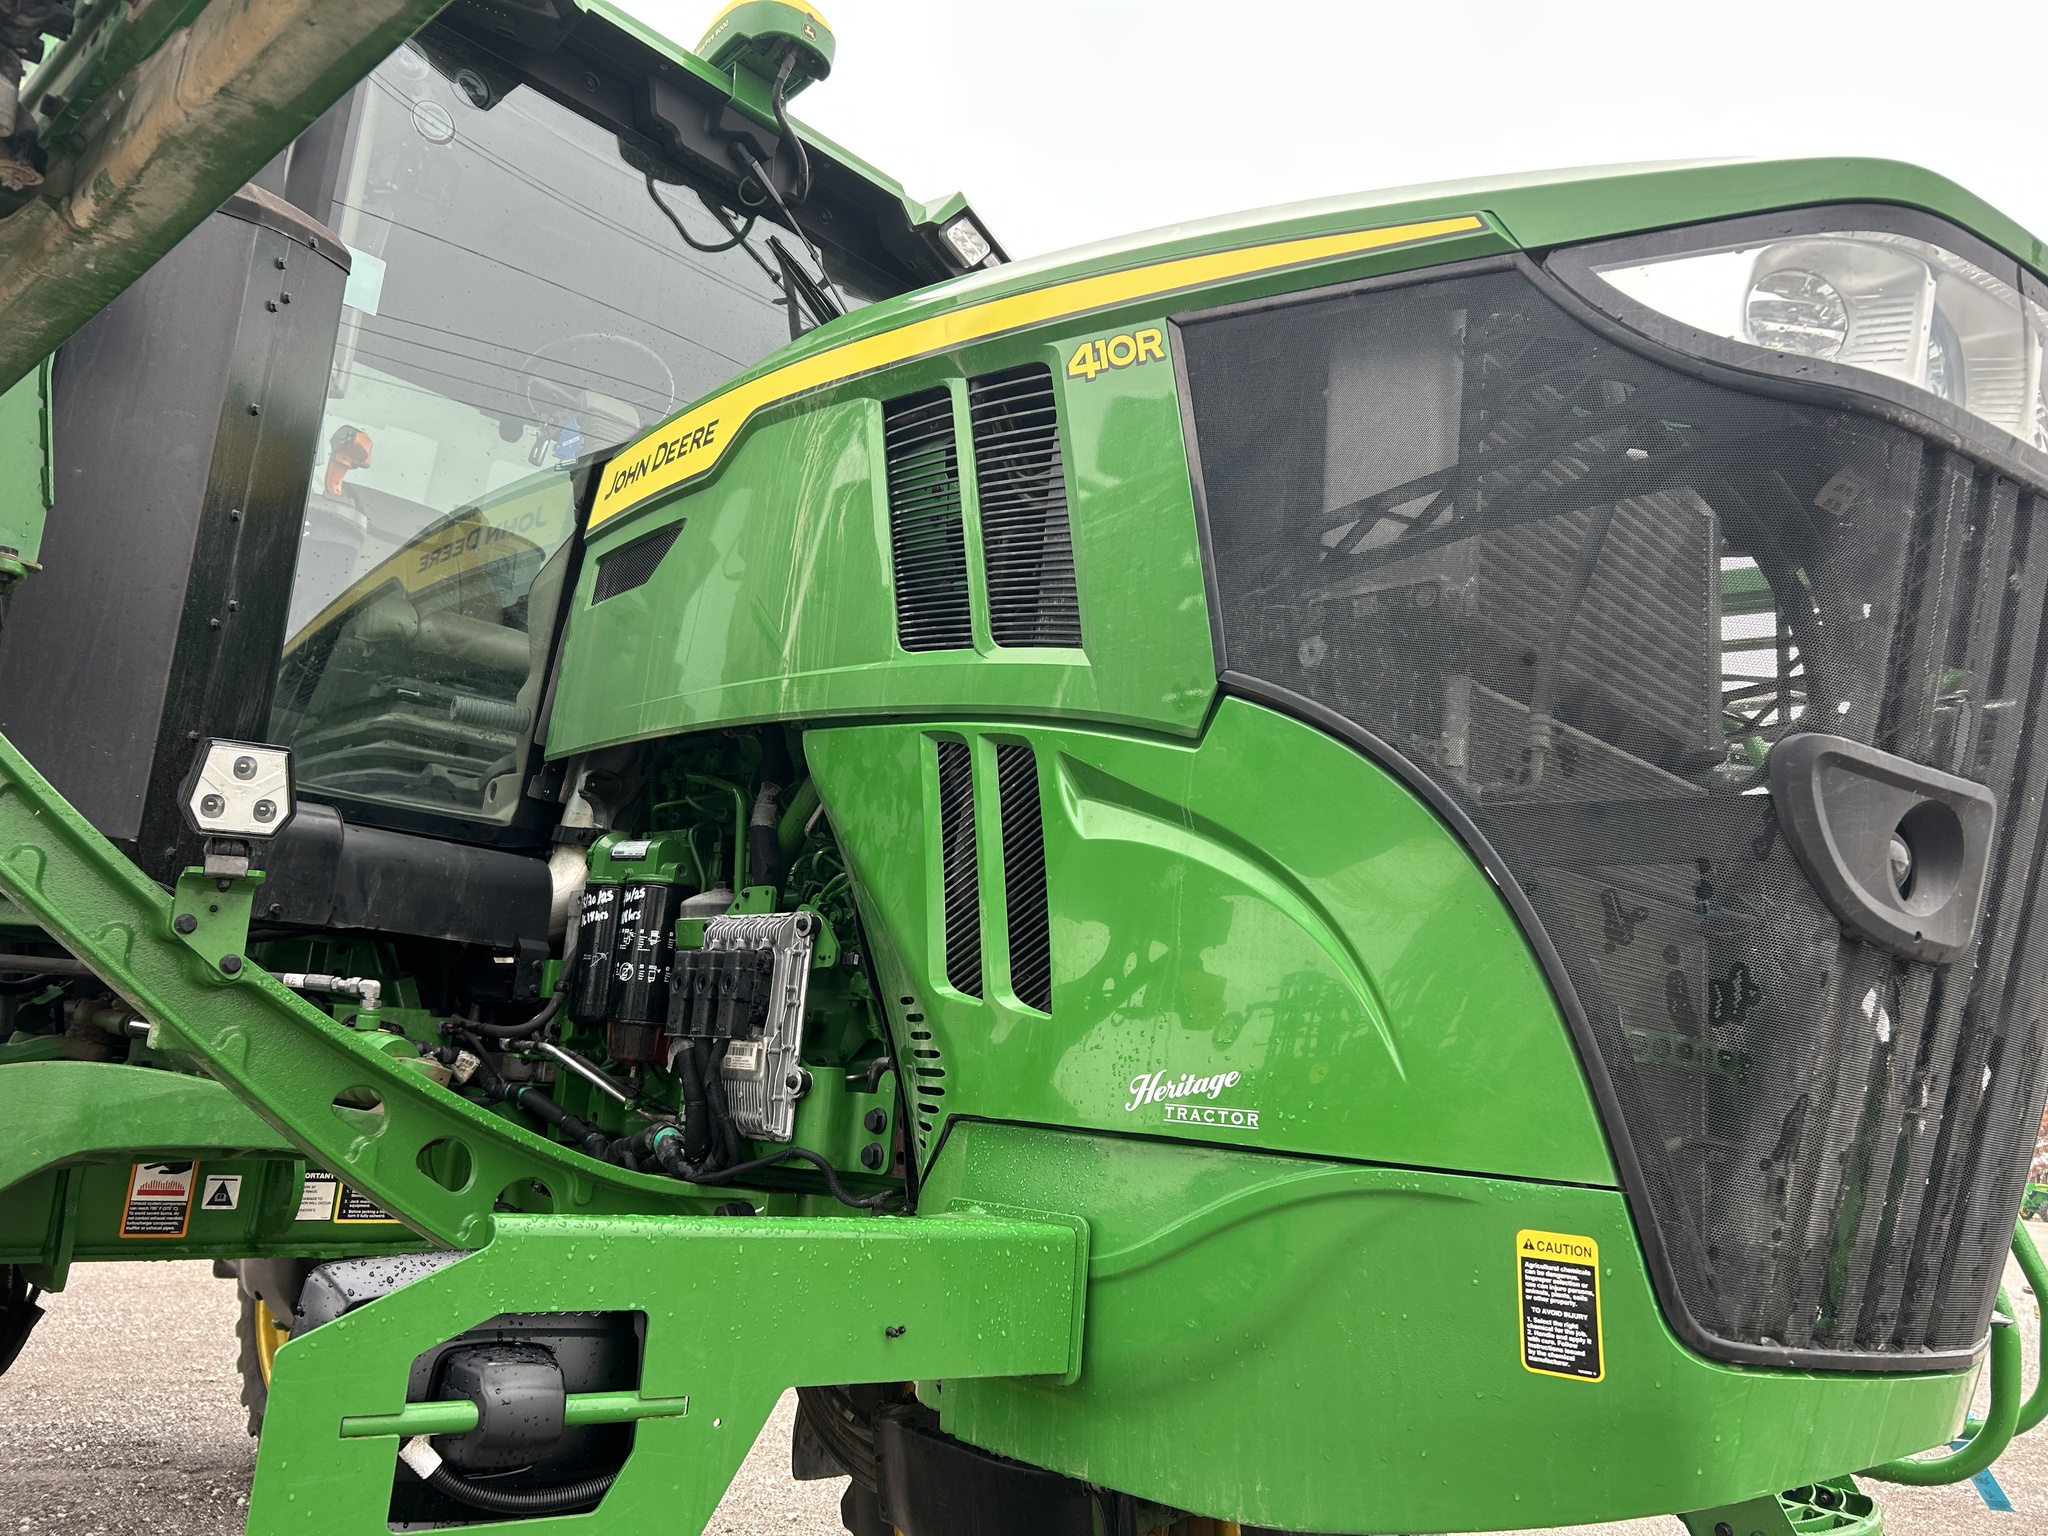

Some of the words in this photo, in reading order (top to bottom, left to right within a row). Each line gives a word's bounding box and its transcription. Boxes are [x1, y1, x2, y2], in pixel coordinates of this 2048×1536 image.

[1066, 328, 1167, 383] 410R
[604, 454, 651, 500] JOHN
[651, 419, 719, 472] DEERE
[1125, 1069, 1241, 1112] Heritage
[1165, 1106, 1258, 1126] TRACTOR
[1536, 1240, 1592, 1258] CAUTION
[1525, 1262, 1559, 1271] Agricultural
[1560, 1267, 1591, 1276] chemicals
[1525, 1274, 1551, 1283] Improper
[1553, 1279, 1580, 1287] selection
[1549, 1284, 1566, 1293] injure
[1550, 1298, 1578, 1307] property.
[1531, 1306, 1541, 1314] TO
[1542, 1308, 1562, 1317] AVOID
[1564, 1311, 1588, 1320] INJURY
[1533, 1317, 1552, 1325] Select
[1564, 1322, 1579, 1330] right
[1527, 1324, 1553, 1332] chemical
[1576, 1330, 1588, 1338] job.
[1534, 1330, 1555, 1339] Handle
[1569, 1336, 1586, 1345] apply
[1527, 1342, 1563, 1353] instructions
[1564, 1348, 1585, 1356] issued
[1557, 1340, 1578, 1349] Follow
[1528, 1348, 1536, 1356] by
[1548, 1351, 1575, 1361] chemical
